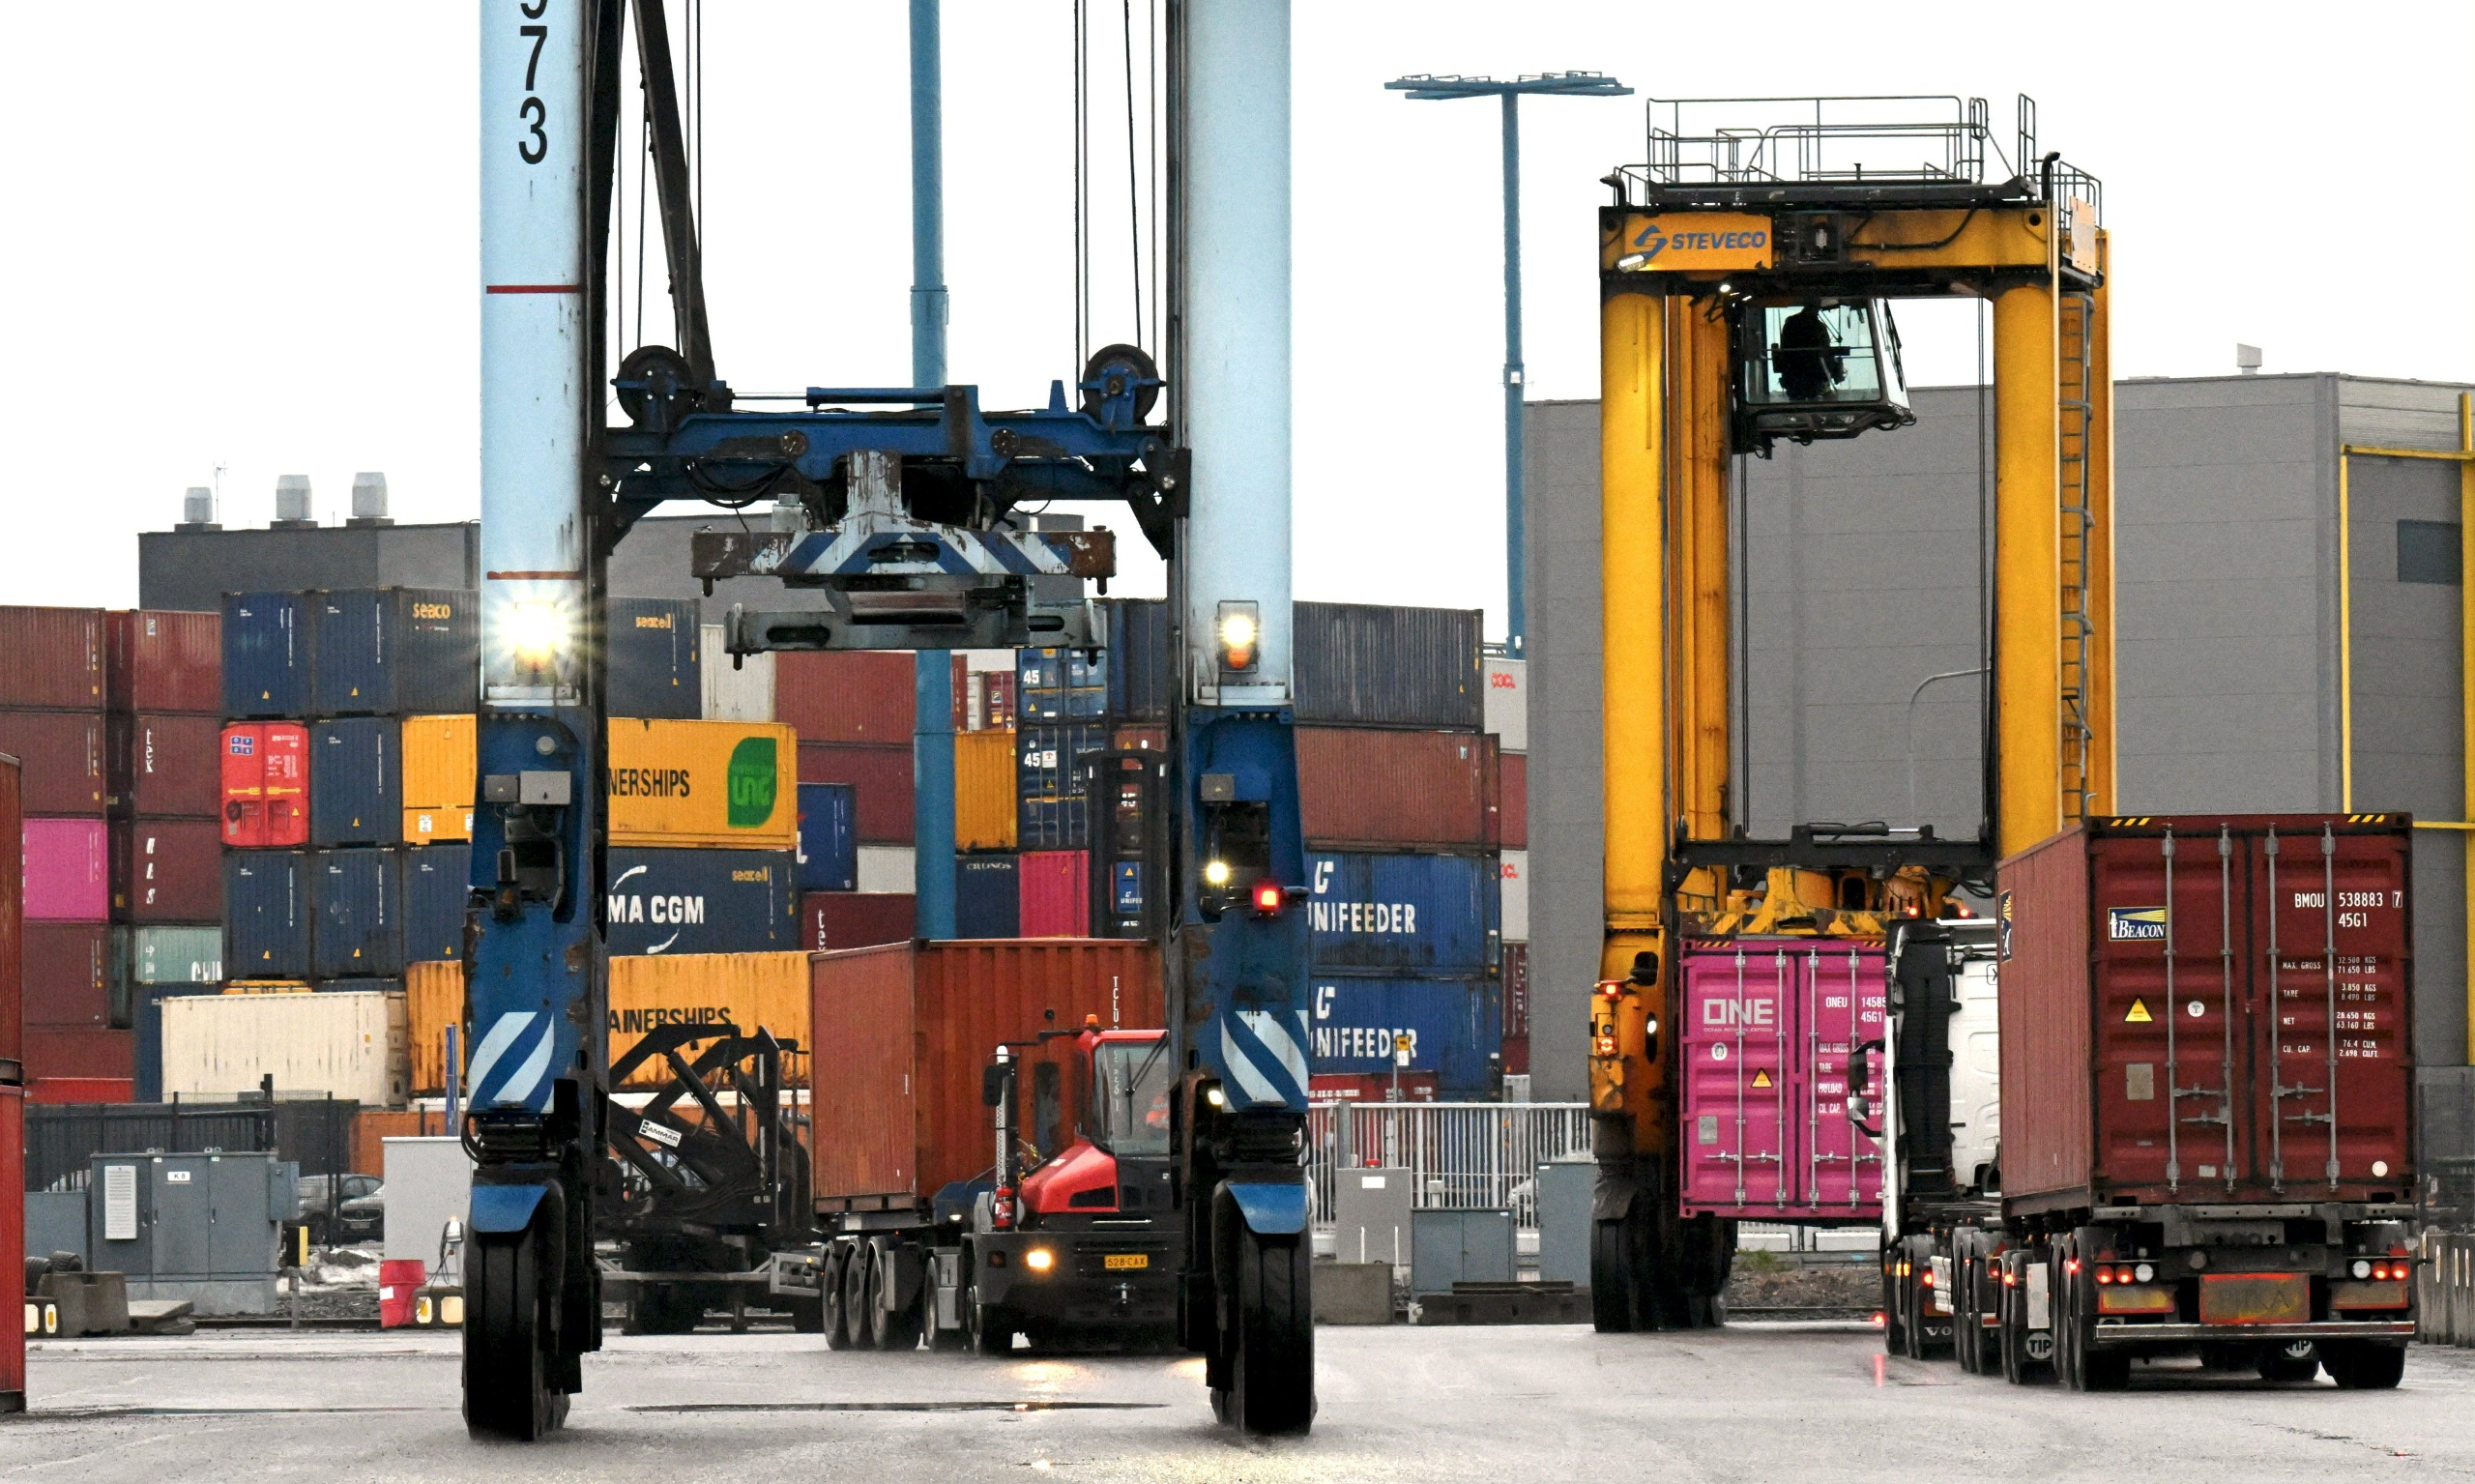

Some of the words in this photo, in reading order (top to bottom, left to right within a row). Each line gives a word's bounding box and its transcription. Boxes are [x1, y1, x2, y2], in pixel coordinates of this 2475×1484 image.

[1671, 231, 1766, 249] STEVECO
[413, 602, 451, 619] seaco
[1023, 670, 1039, 684] 45
[1024, 752, 1040, 767] 45
[2294, 892, 2325, 908] BMOU
[2339, 891, 2383, 908] 538883
[2394, 891, 2401, 907] 7
[608, 895, 645, 923] MA
[651, 895, 705, 923] CGM
[2338, 913, 2368, 928] 45G1
[2117, 919, 2166, 939] BEACON
[2341, 983, 2360, 992] 3.850
[2364, 983, 2376, 992] KGS
[2283, 989, 2299, 998] TARE
[2364, 993, 2375, 1002] LBS
[1825, 997, 1848, 1008] ONEU
[1703, 998, 1774, 1025] ONE
[1860, 1010, 1882, 1023] 45G1
[2336, 1011, 2360, 1020] 28.650
[2283, 1017, 2295, 1026] NET
[2336, 1021, 2359, 1030] 63.160
[2343, 1039, 2358, 1048] 76.4
[2297, 1045, 2312, 1054] CAP.
[2339, 1049, 2358, 1058] 2.698
[1819, 1062, 1832, 1073] TARE
[1819, 1083, 1843, 1094] PAYLOAD
[2028, 1340, 2053, 1353] TIP
